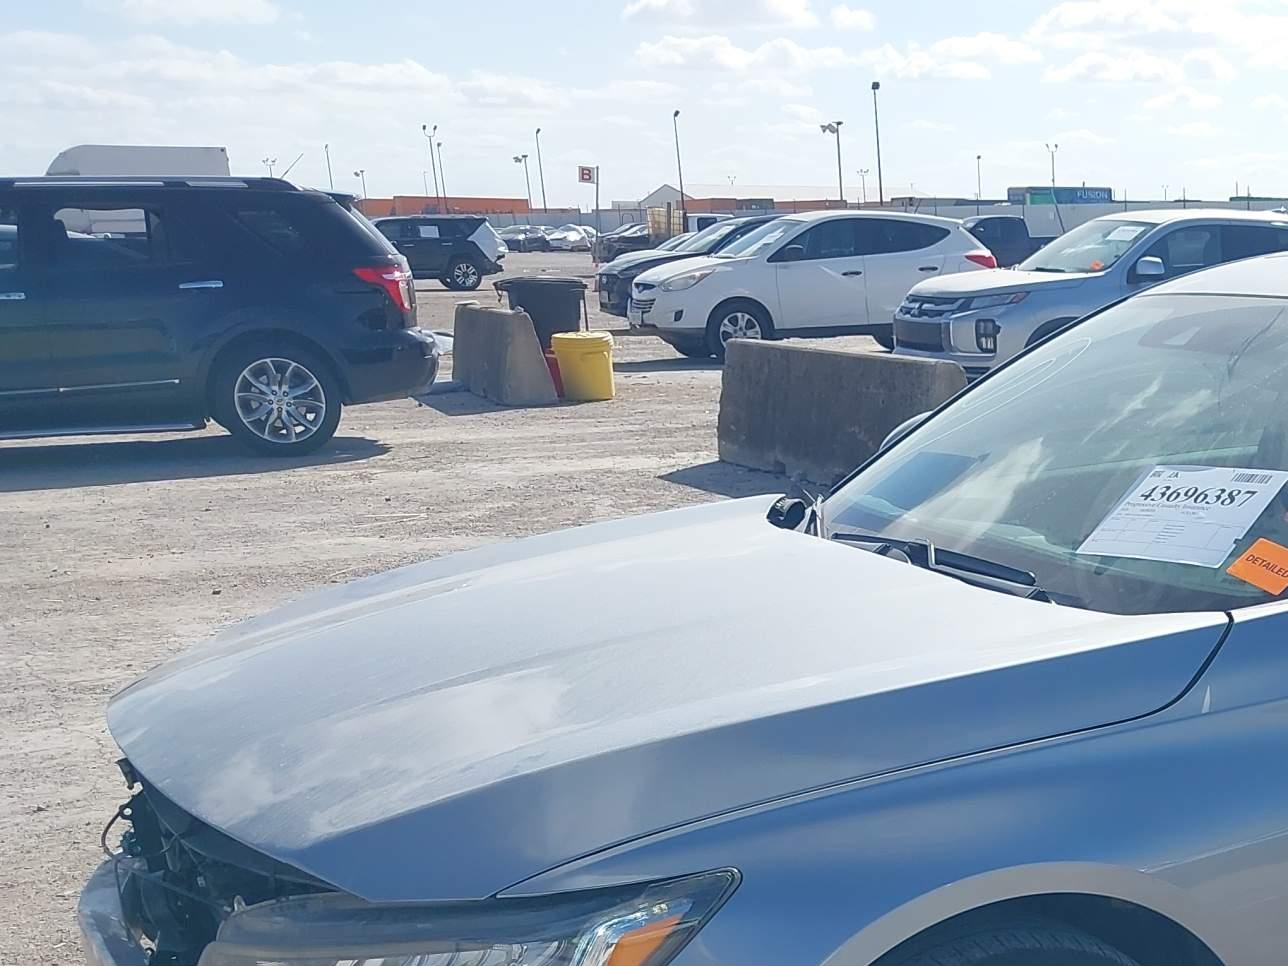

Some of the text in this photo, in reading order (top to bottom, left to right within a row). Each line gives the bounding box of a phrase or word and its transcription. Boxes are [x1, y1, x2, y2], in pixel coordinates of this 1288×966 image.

[581, 167, 592, 181] B
[1077, 190, 1108, 200] FUSION
[1140, 485, 1259, 509] 43696387
